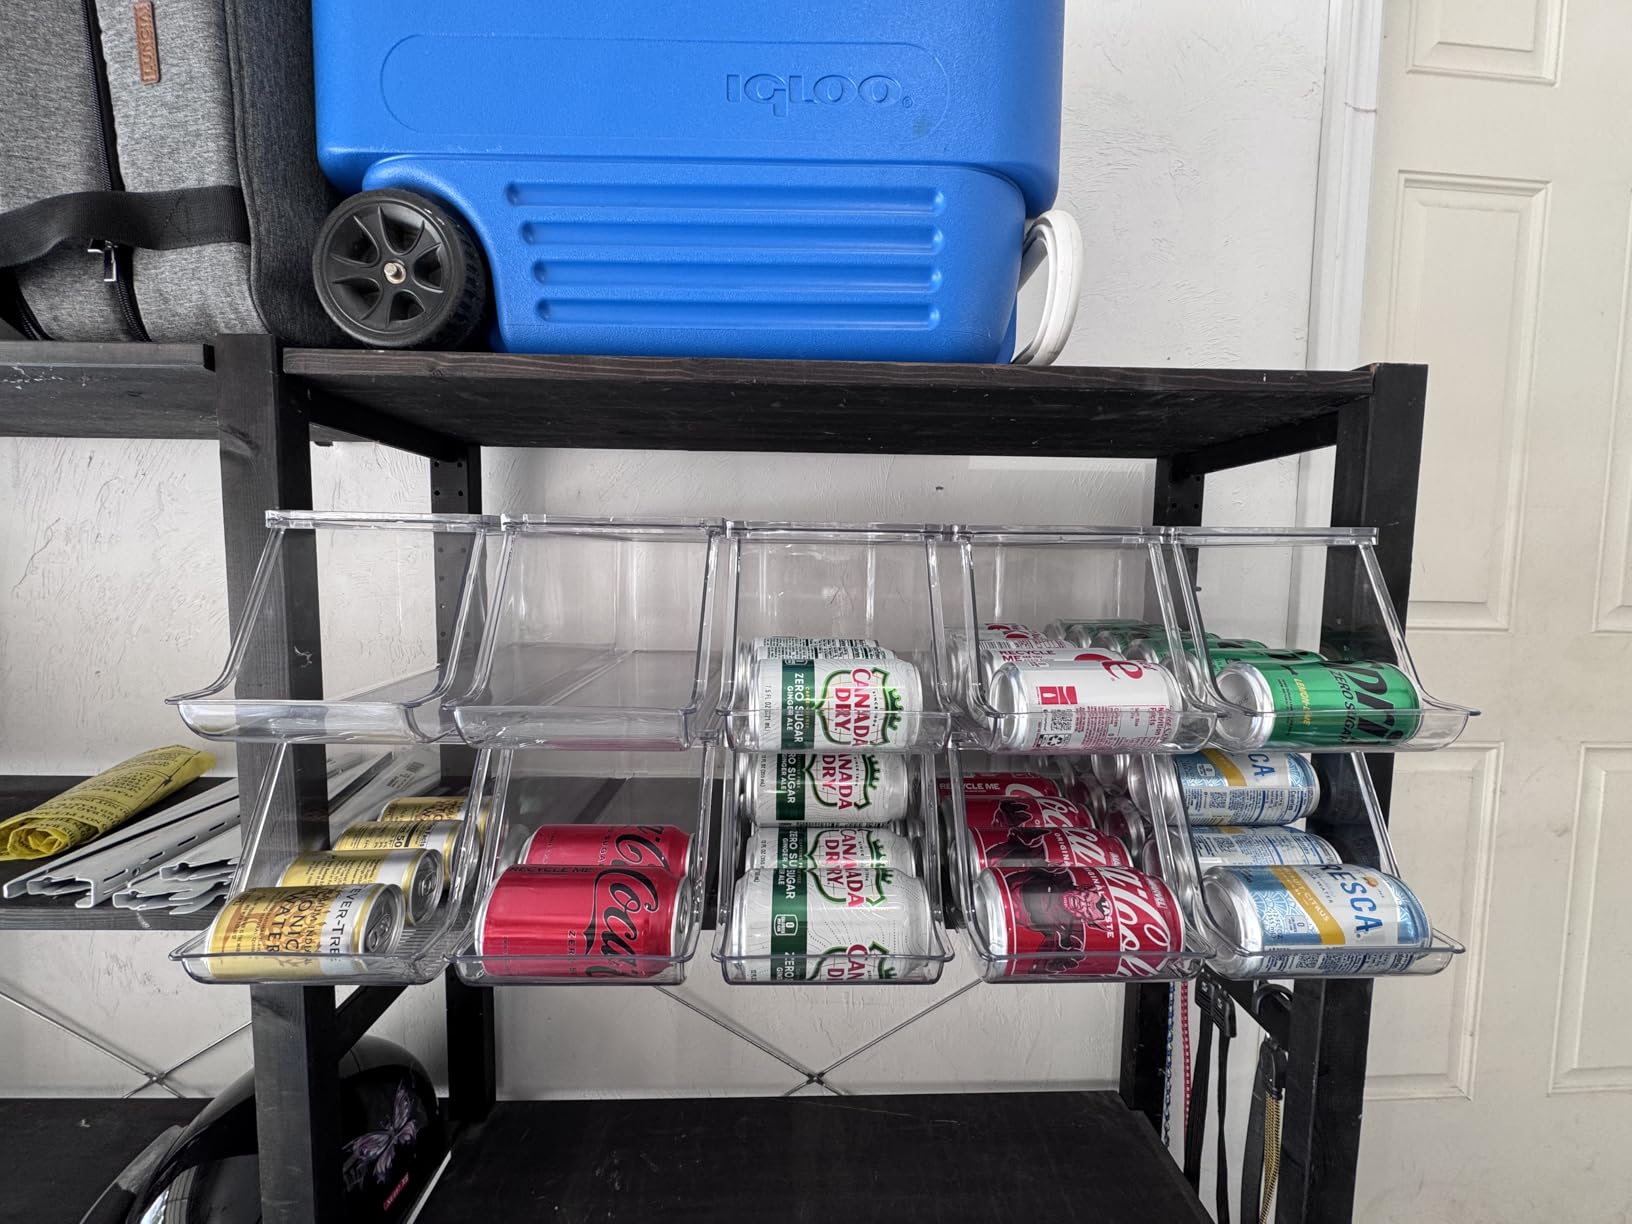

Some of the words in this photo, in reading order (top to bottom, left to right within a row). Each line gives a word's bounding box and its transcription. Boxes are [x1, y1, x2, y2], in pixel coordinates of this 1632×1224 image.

[726, 74, 902, 117] IGLOO
[786, 685, 794, 715] GINGER
[794, 673, 804, 702] ZERO
[1330, 670, 1354, 700] ZERO
[793, 705, 804, 743] SUGAR
[852, 668, 872, 747] CANADA
[787, 767, 796, 804] SUGAR
[781, 838, 789, 862] GINGER
[789, 831, 798, 850] ZERO
[1304, 892, 1330, 922] CITRUS
[1314, 864, 1384, 932] RESCA
[266, 890, 303, 952] WATER
[1100, 900, 1114, 939] TASTE
